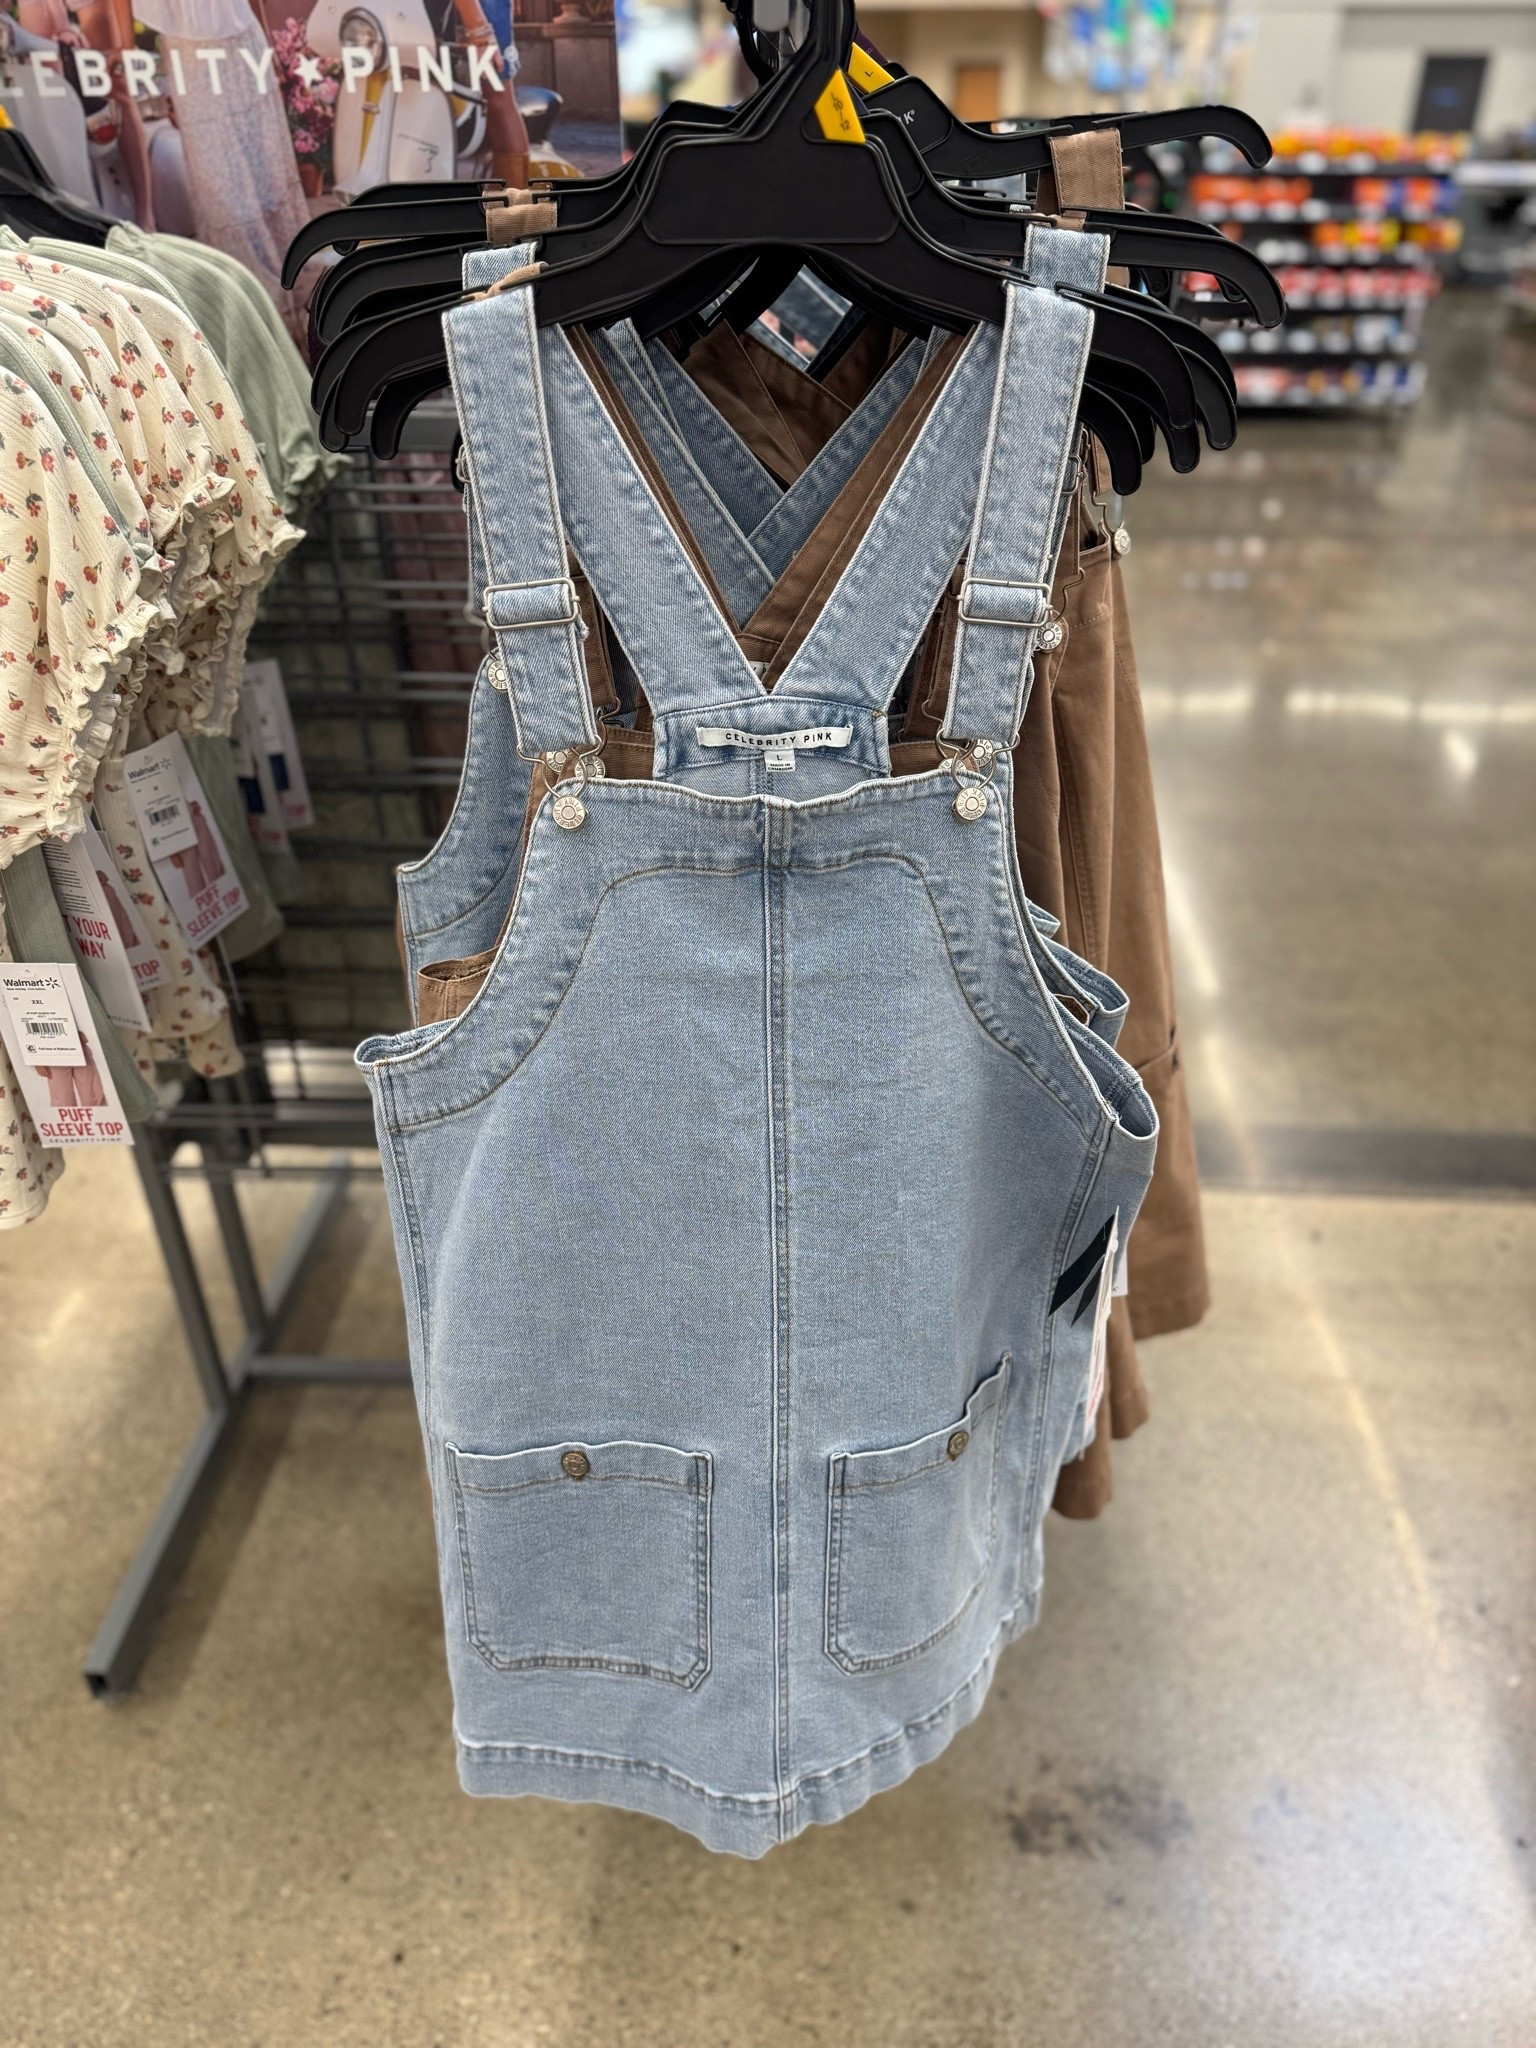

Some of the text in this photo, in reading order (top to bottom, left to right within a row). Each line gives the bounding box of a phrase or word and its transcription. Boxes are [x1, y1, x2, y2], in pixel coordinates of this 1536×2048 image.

[341, 45, 505, 94] PINK
[864, 70, 874, 78] L
[833, 100, 843, 112] 10
[840, 120, 851, 132] 12
[725, 732, 832, 746] CELEBRITY PINK
[128, 763, 159, 780] Walmart
[74, 917, 112, 941] YOUR
[76, 937, 106, 960] WAY
[132, 960, 160, 979] TOP
[3, 979, 44, 987] Walmart
[58, 1108, 93, 1122] PUFF
[40, 1122, 123, 1137] SLEEVE TOP
